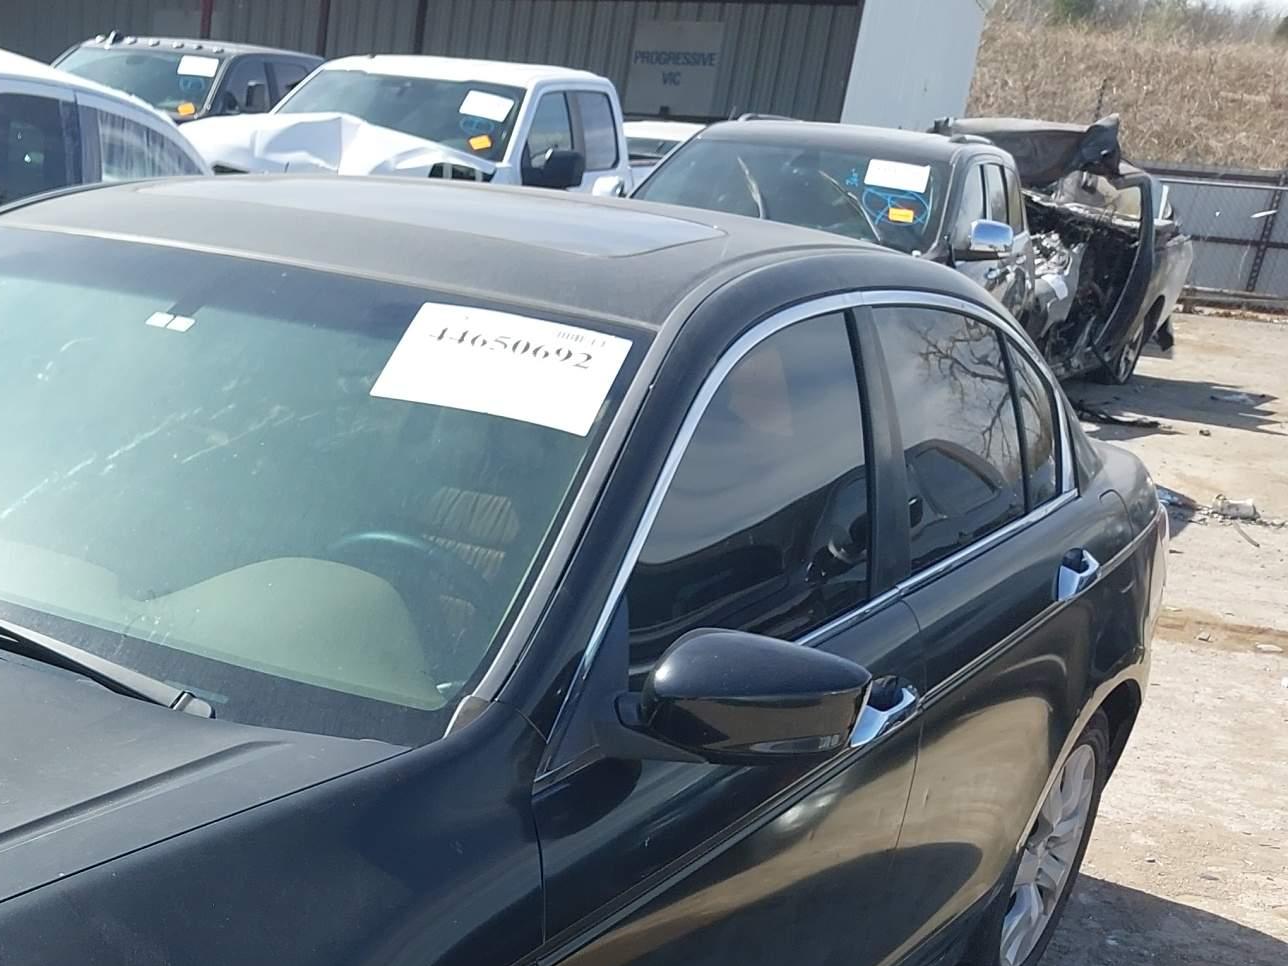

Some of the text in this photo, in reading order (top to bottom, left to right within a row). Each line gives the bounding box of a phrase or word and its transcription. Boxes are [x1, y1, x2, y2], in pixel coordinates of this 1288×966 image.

[633, 50, 716, 66] PROGRESSIVE
[662, 71, 681, 86] VIC
[429, 327, 593, 369] 44650692
